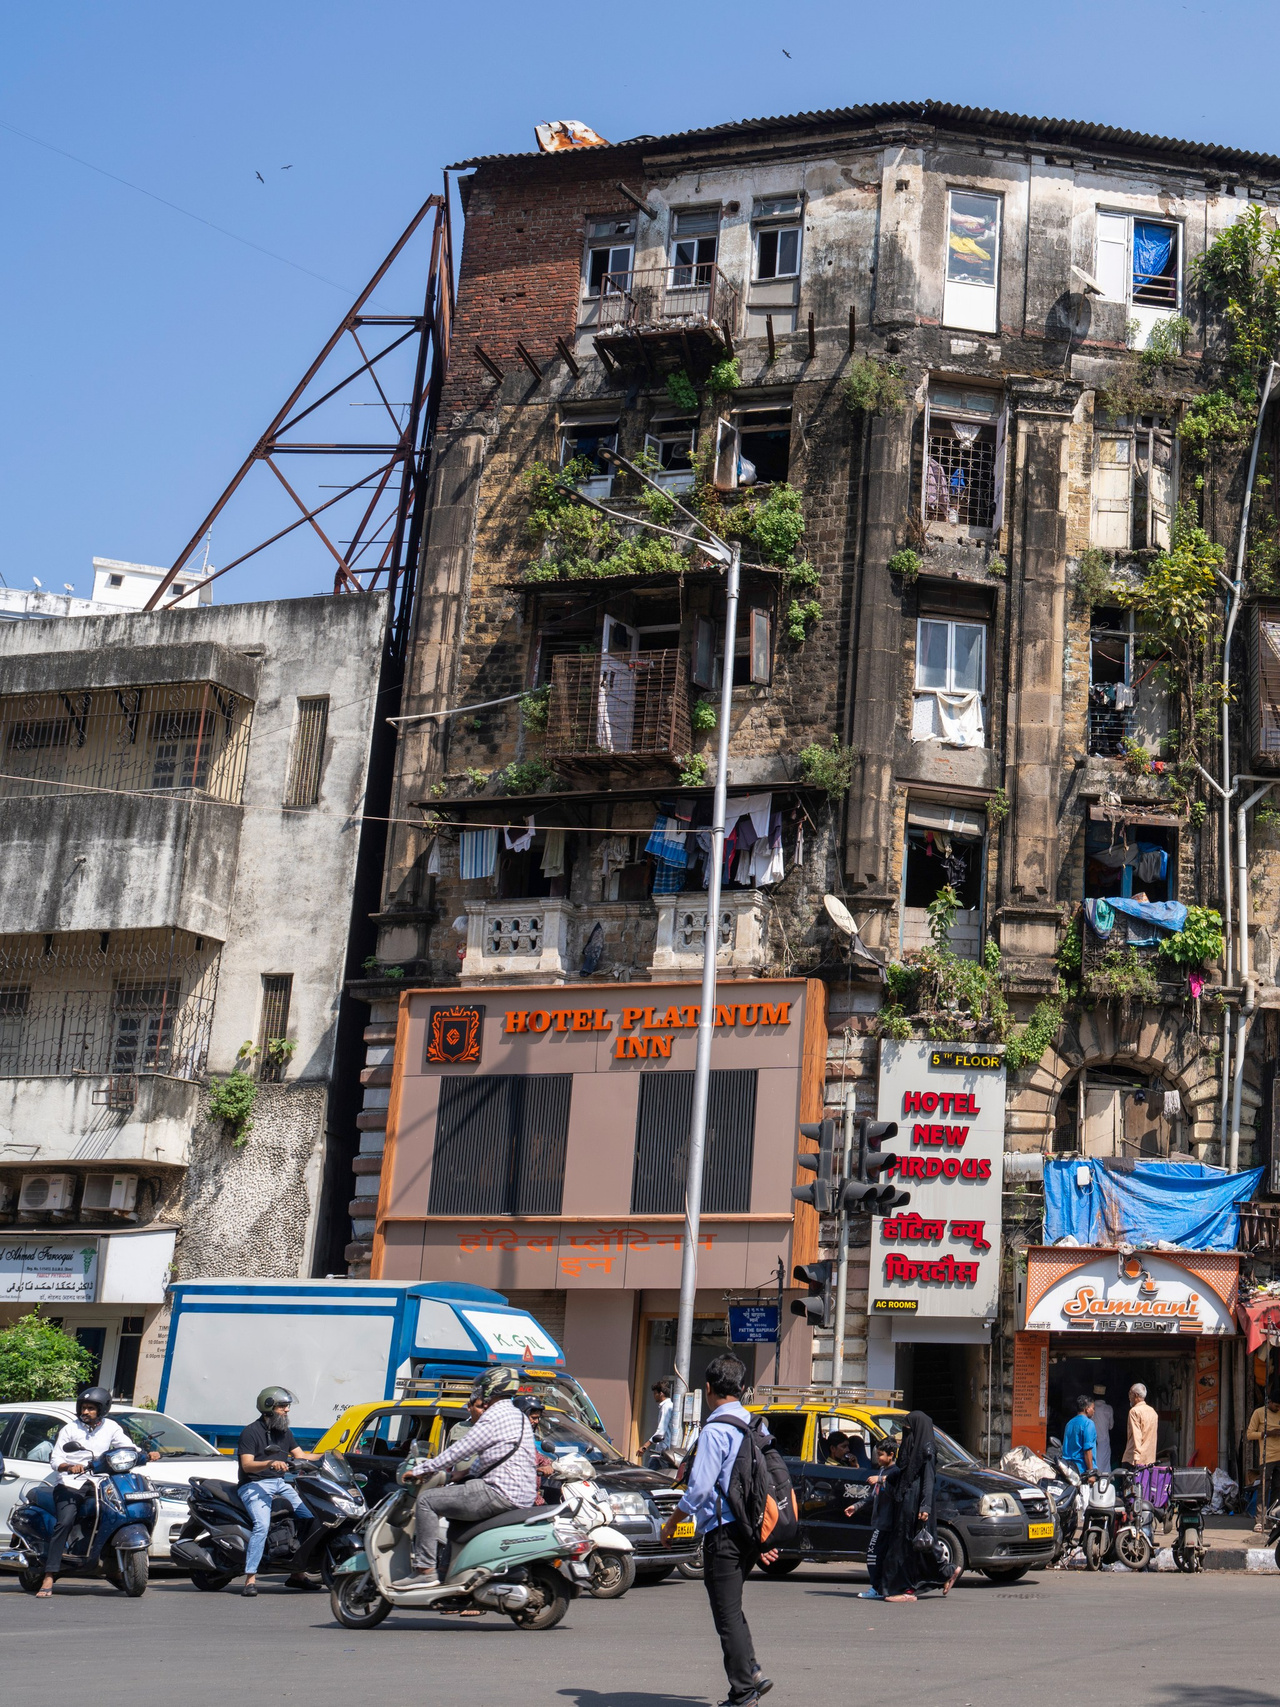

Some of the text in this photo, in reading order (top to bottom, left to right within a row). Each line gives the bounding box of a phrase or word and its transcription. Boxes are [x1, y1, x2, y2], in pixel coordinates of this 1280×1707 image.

[504, 1002, 792, 1033] HOTEL PLATNUM
[614, 1035, 674, 1059] INN
[955, 1055, 1000, 1068] FLOOR
[904, 1091, 981, 1114] HOTEL
[913, 1124, 970, 1146] NEW
[887, 1156, 992, 1179] FIRDOUS
[457, 1228, 558, 1253] हॉटेल
[883, 1212, 992, 1249] हॉटेल न्यू
[5, 1246, 38, 1260] Ahmed
[37, 1246, 75, 1266] Farooqui
[558, 1256, 617, 1277] इन
[885, 1253, 980, 1283] फिरदौस
[876, 1300, 917, 1309] AC ROOMS
[1064, 1286, 1200, 1318] Samnani
[1100, 1319, 1176, 1331] TEA POINT
